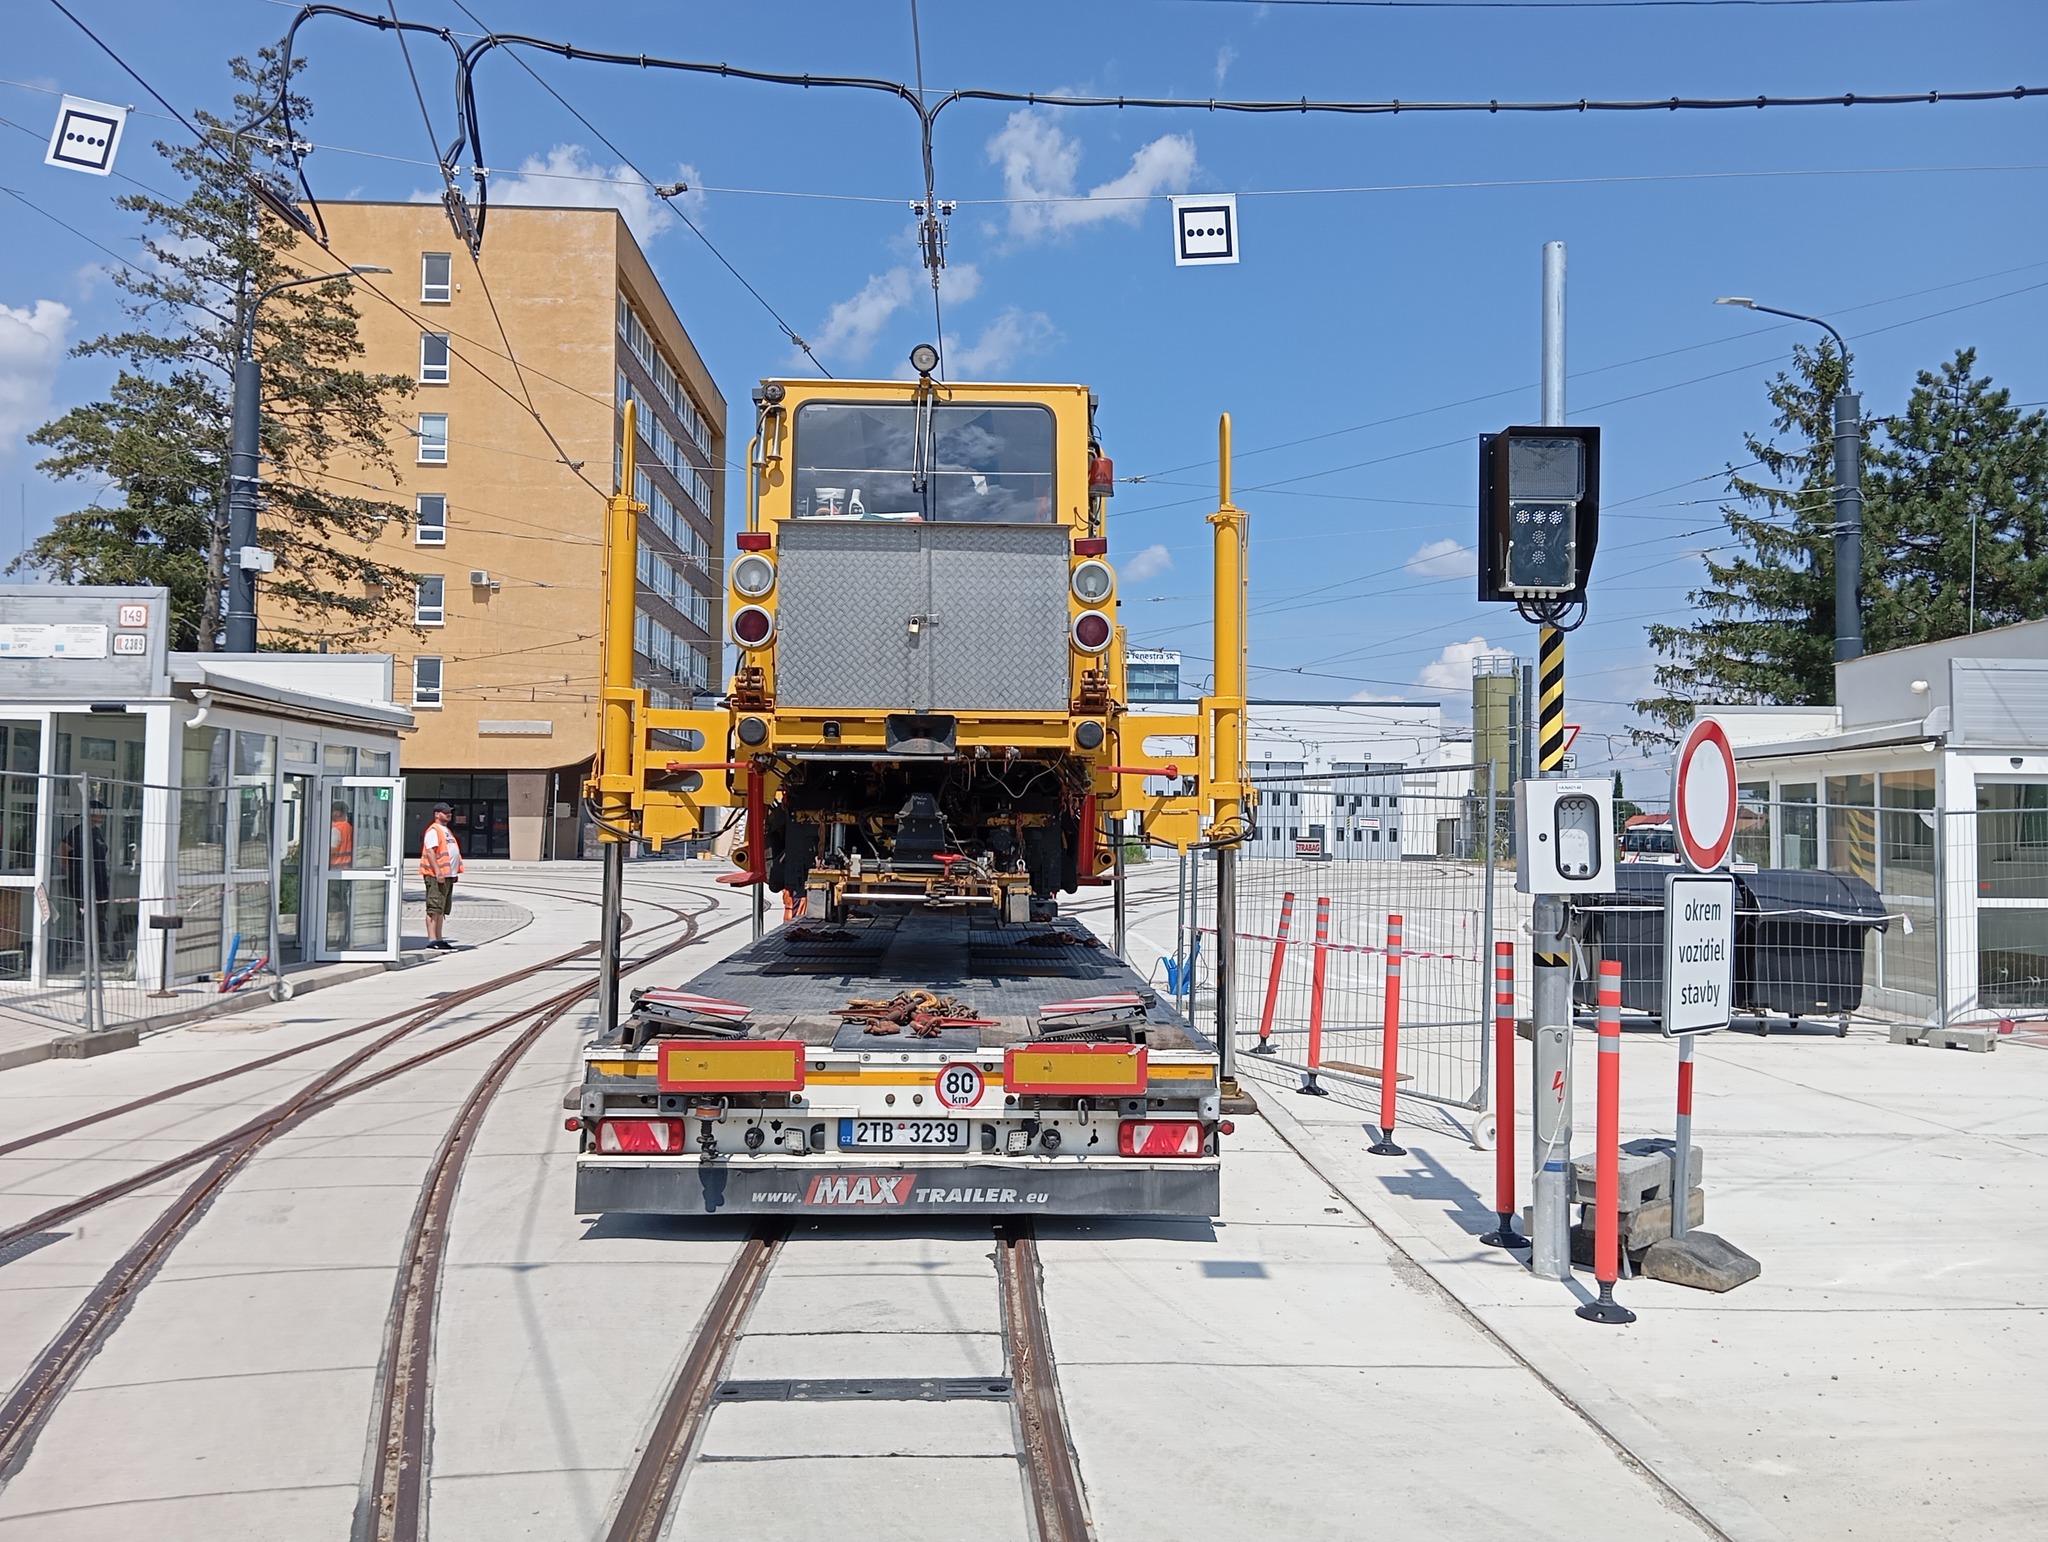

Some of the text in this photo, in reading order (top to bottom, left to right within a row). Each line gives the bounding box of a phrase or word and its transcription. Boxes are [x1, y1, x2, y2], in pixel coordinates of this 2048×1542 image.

[123, 609, 142, 622] 149
[125, 638, 143, 650] 2389
[1296, 843, 1320, 851] STRABAG
[1684, 898, 1721, 921] okrem
[1679, 938, 1725, 963] vozidiel
[1681, 980, 1720, 1007] stavby
[946, 1072, 974, 1094] 80
[951, 1094, 969, 1104] km
[857, 1122, 958, 1143] 2TB 3239
[812, 1177, 904, 1204] MAX
